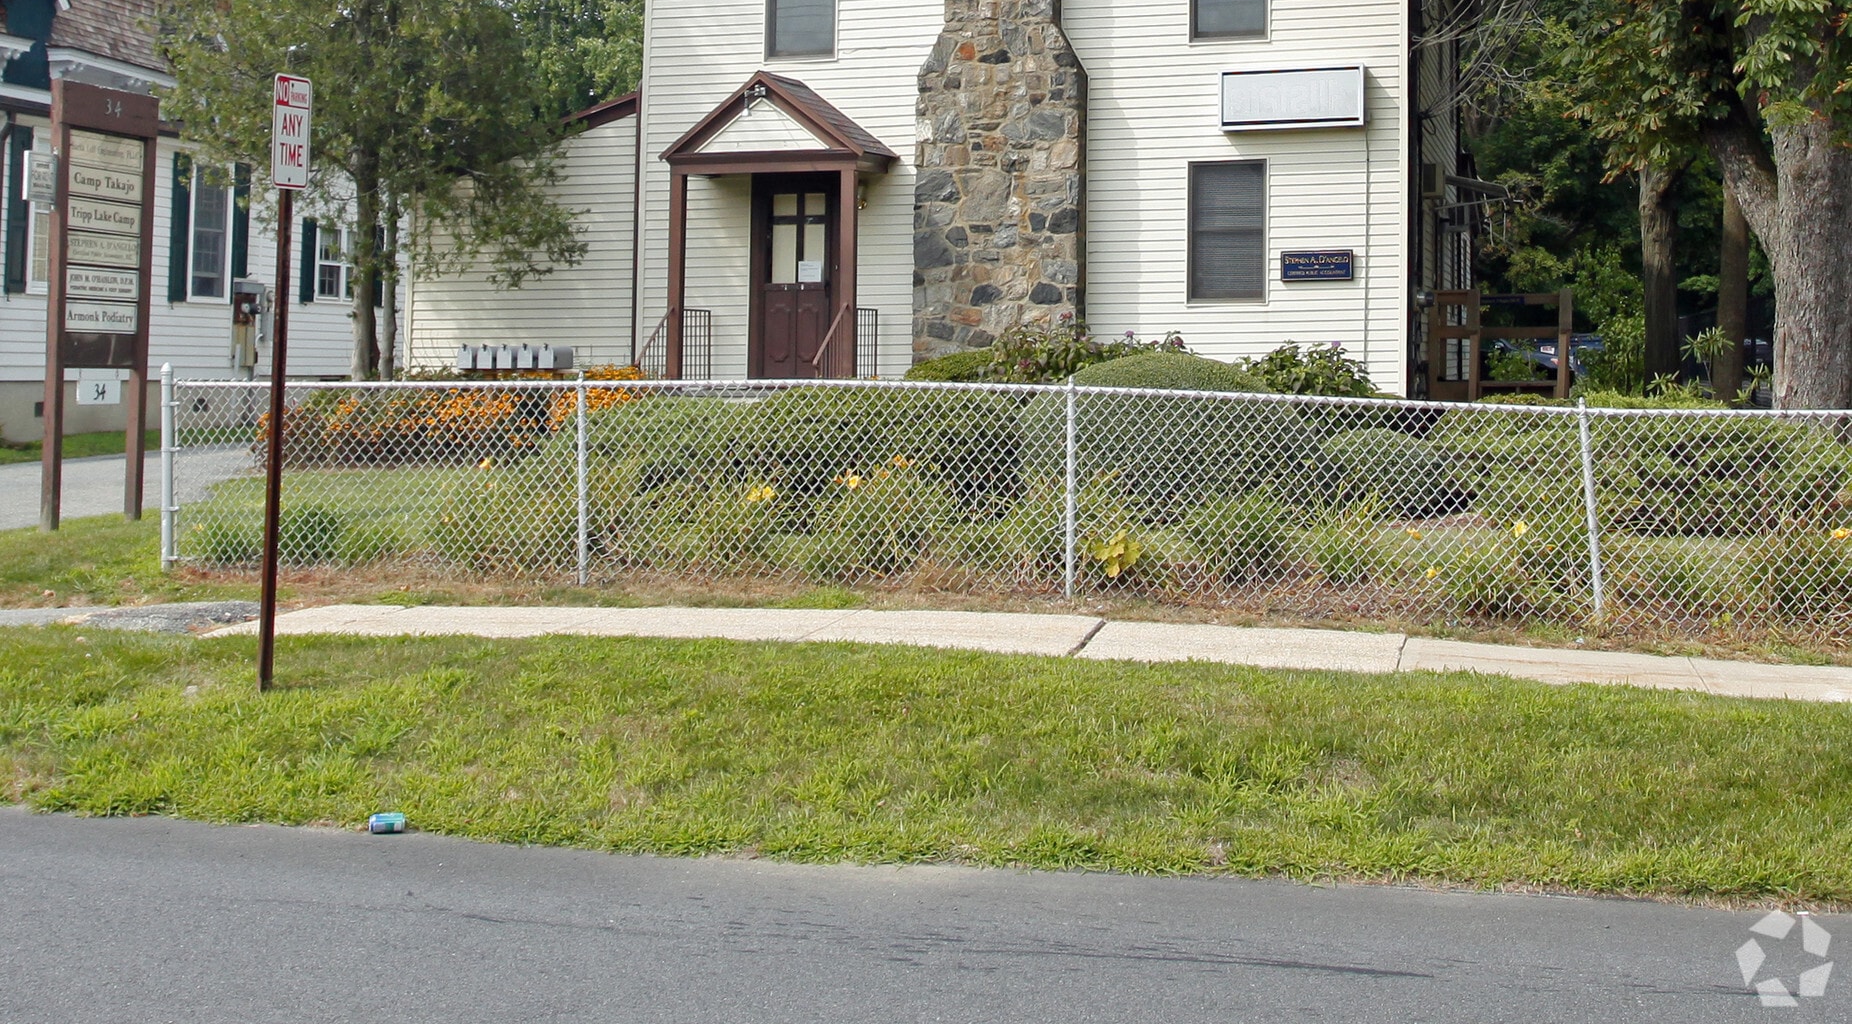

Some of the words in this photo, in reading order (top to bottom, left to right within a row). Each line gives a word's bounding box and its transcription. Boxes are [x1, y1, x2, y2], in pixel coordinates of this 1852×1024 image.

[276, 80, 289, 102] NO
[290, 91, 308, 104] PARKING
[104, 98, 123, 118] 34
[281, 112, 303, 138] ANY
[279, 142, 304, 168] TIME
[74, 171, 102, 192] Camp
[104, 176, 135, 195] Takajo
[71, 206, 93, 224] Tripp
[94, 209, 112, 223] Lake
[113, 212, 136, 229] Camp
[70, 238, 98, 249] STEPHEN
[1284, 256, 1309, 265] STEPHEN
[69, 273, 83, 282] JOHN
[67, 309, 100, 322] Armonk
[102, 311, 134, 327] Podiatry
[93, 382, 107, 401] 34
